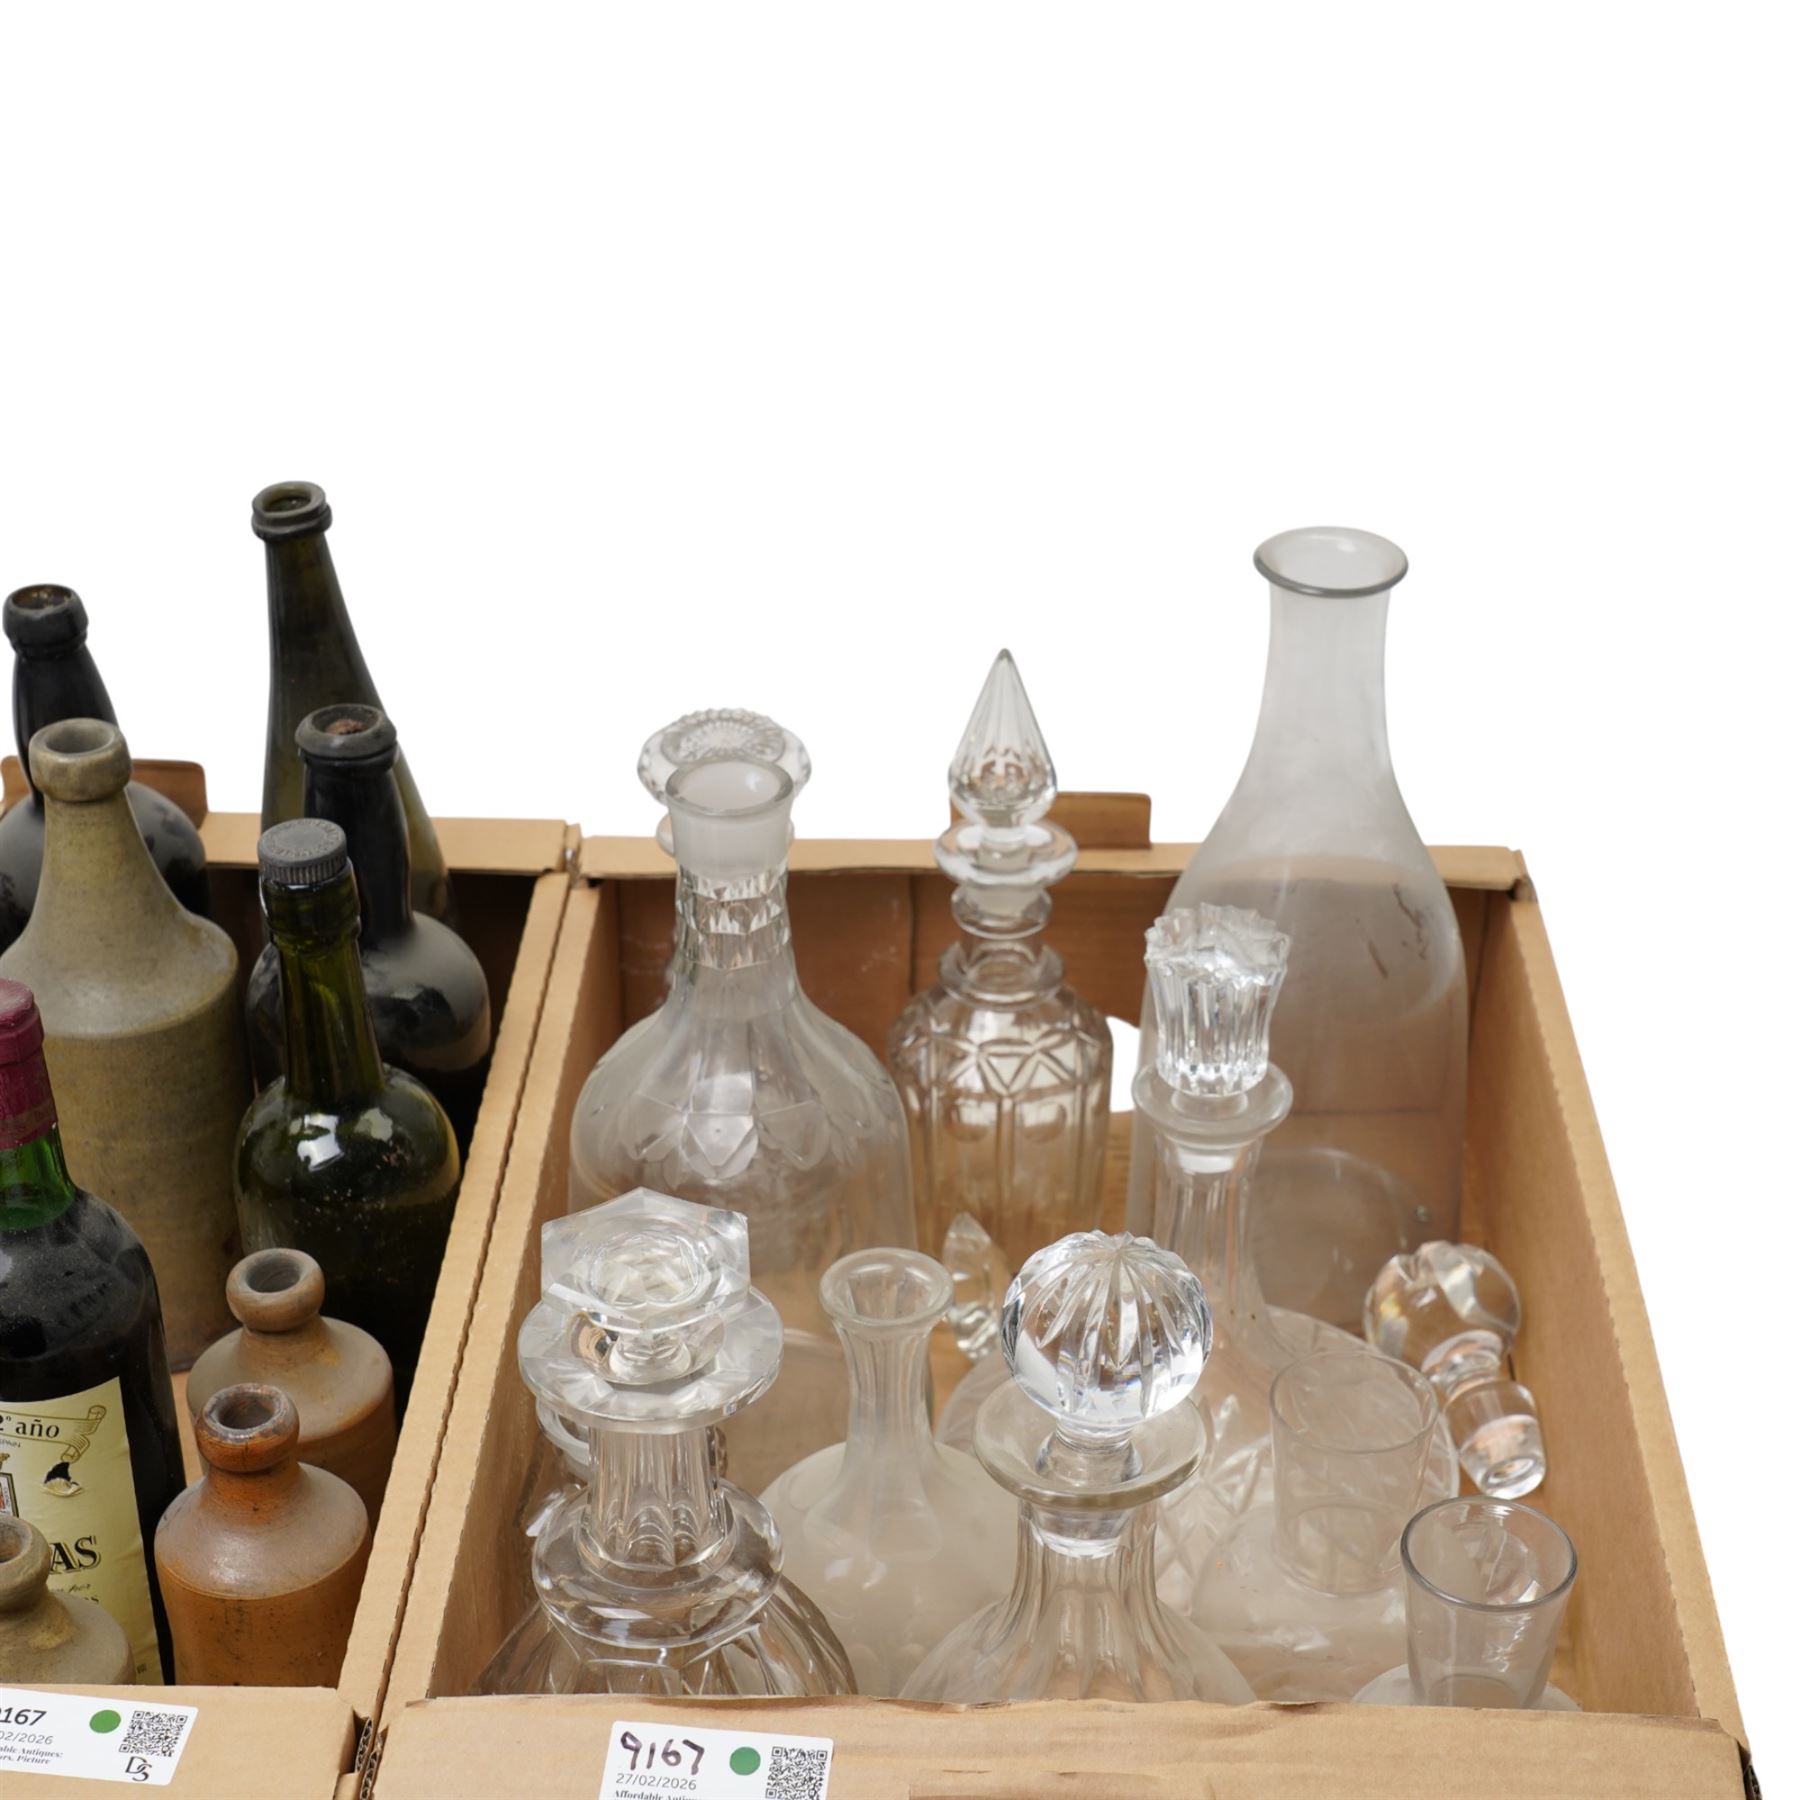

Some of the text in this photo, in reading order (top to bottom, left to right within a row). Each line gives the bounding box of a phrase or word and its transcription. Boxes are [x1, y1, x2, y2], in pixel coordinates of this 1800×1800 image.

[15, 1418, 60, 1439] año
[49, 1535, 101, 1573] AS
[0, 1706, 47, 1726] 167
[16, 1755, 50, 1765] Picture
[620, 1730, 705, 1776] 9167
[616, 1772, 697, 1791] 27/02/2026
